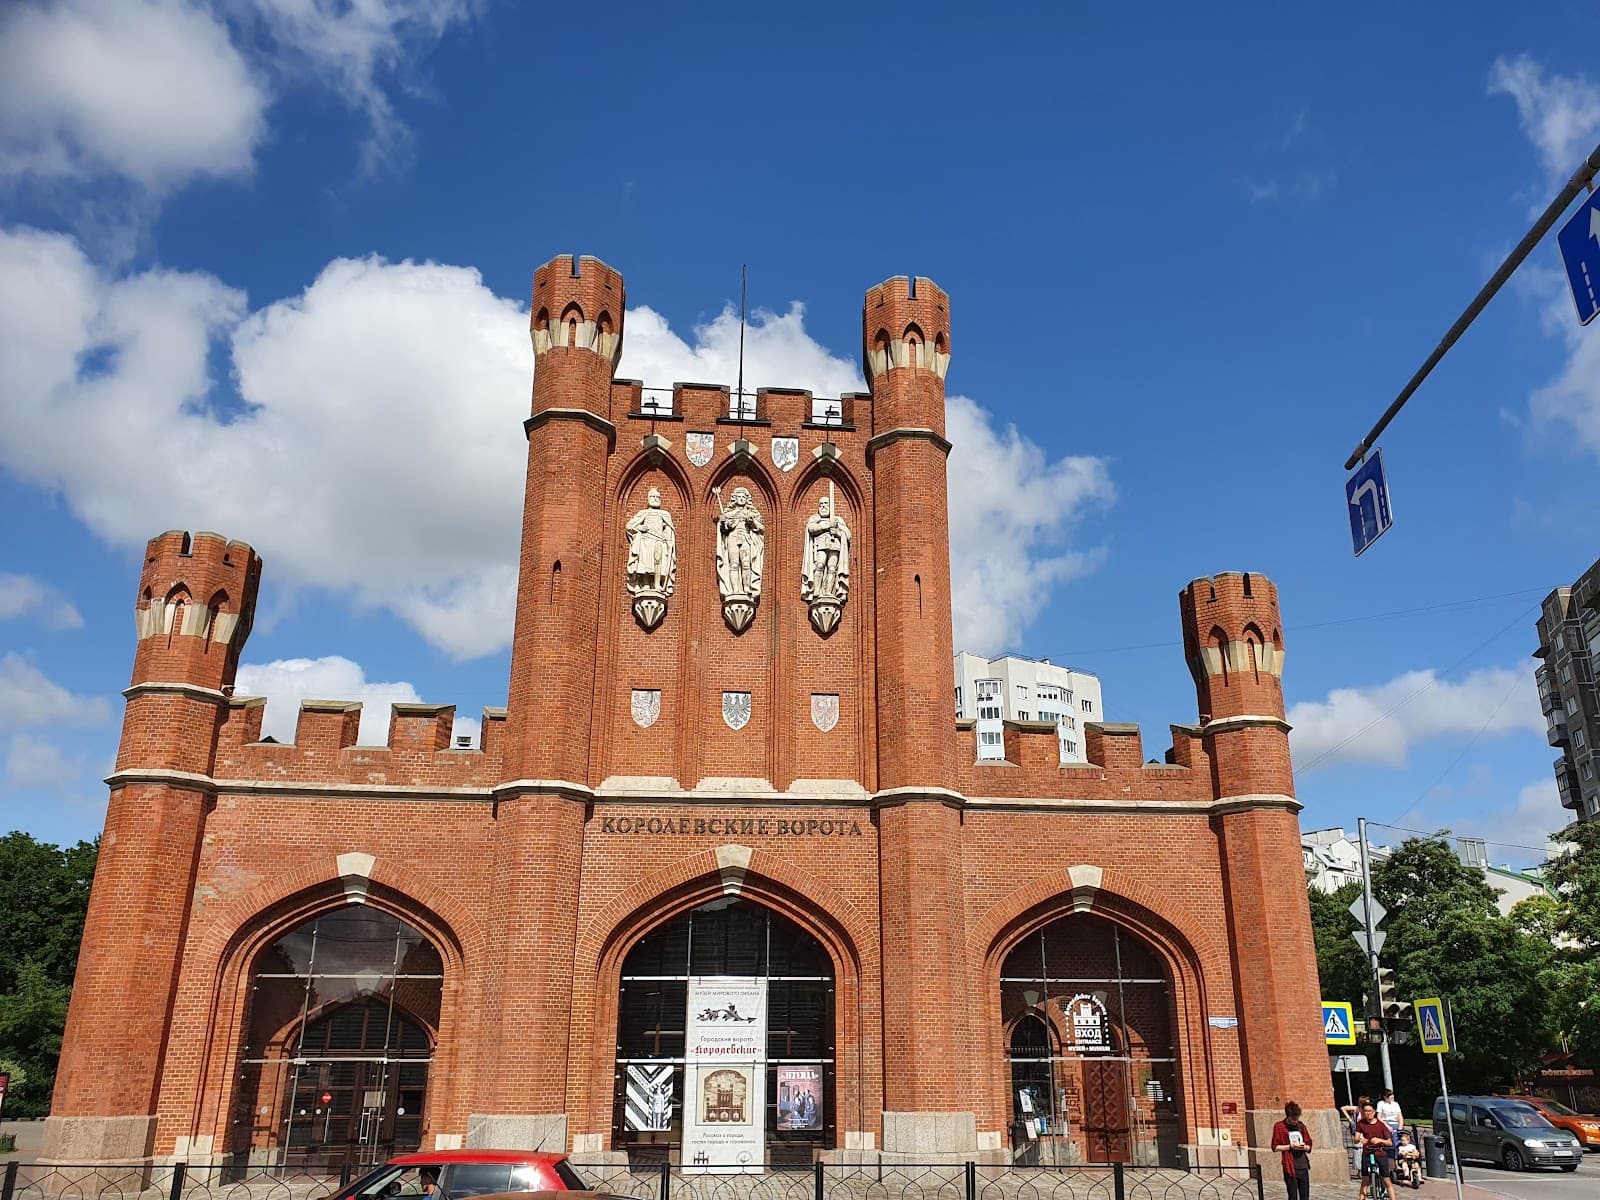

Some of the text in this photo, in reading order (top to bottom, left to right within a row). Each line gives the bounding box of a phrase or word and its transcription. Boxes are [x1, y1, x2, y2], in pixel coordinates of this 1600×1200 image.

[601, 816, 862, 835] КОРОЛЕВСКИЕ ВОРОТА
[700, 1035, 731, 1043] Городские
[1075, 1029, 1102, 1039] ВХОД
